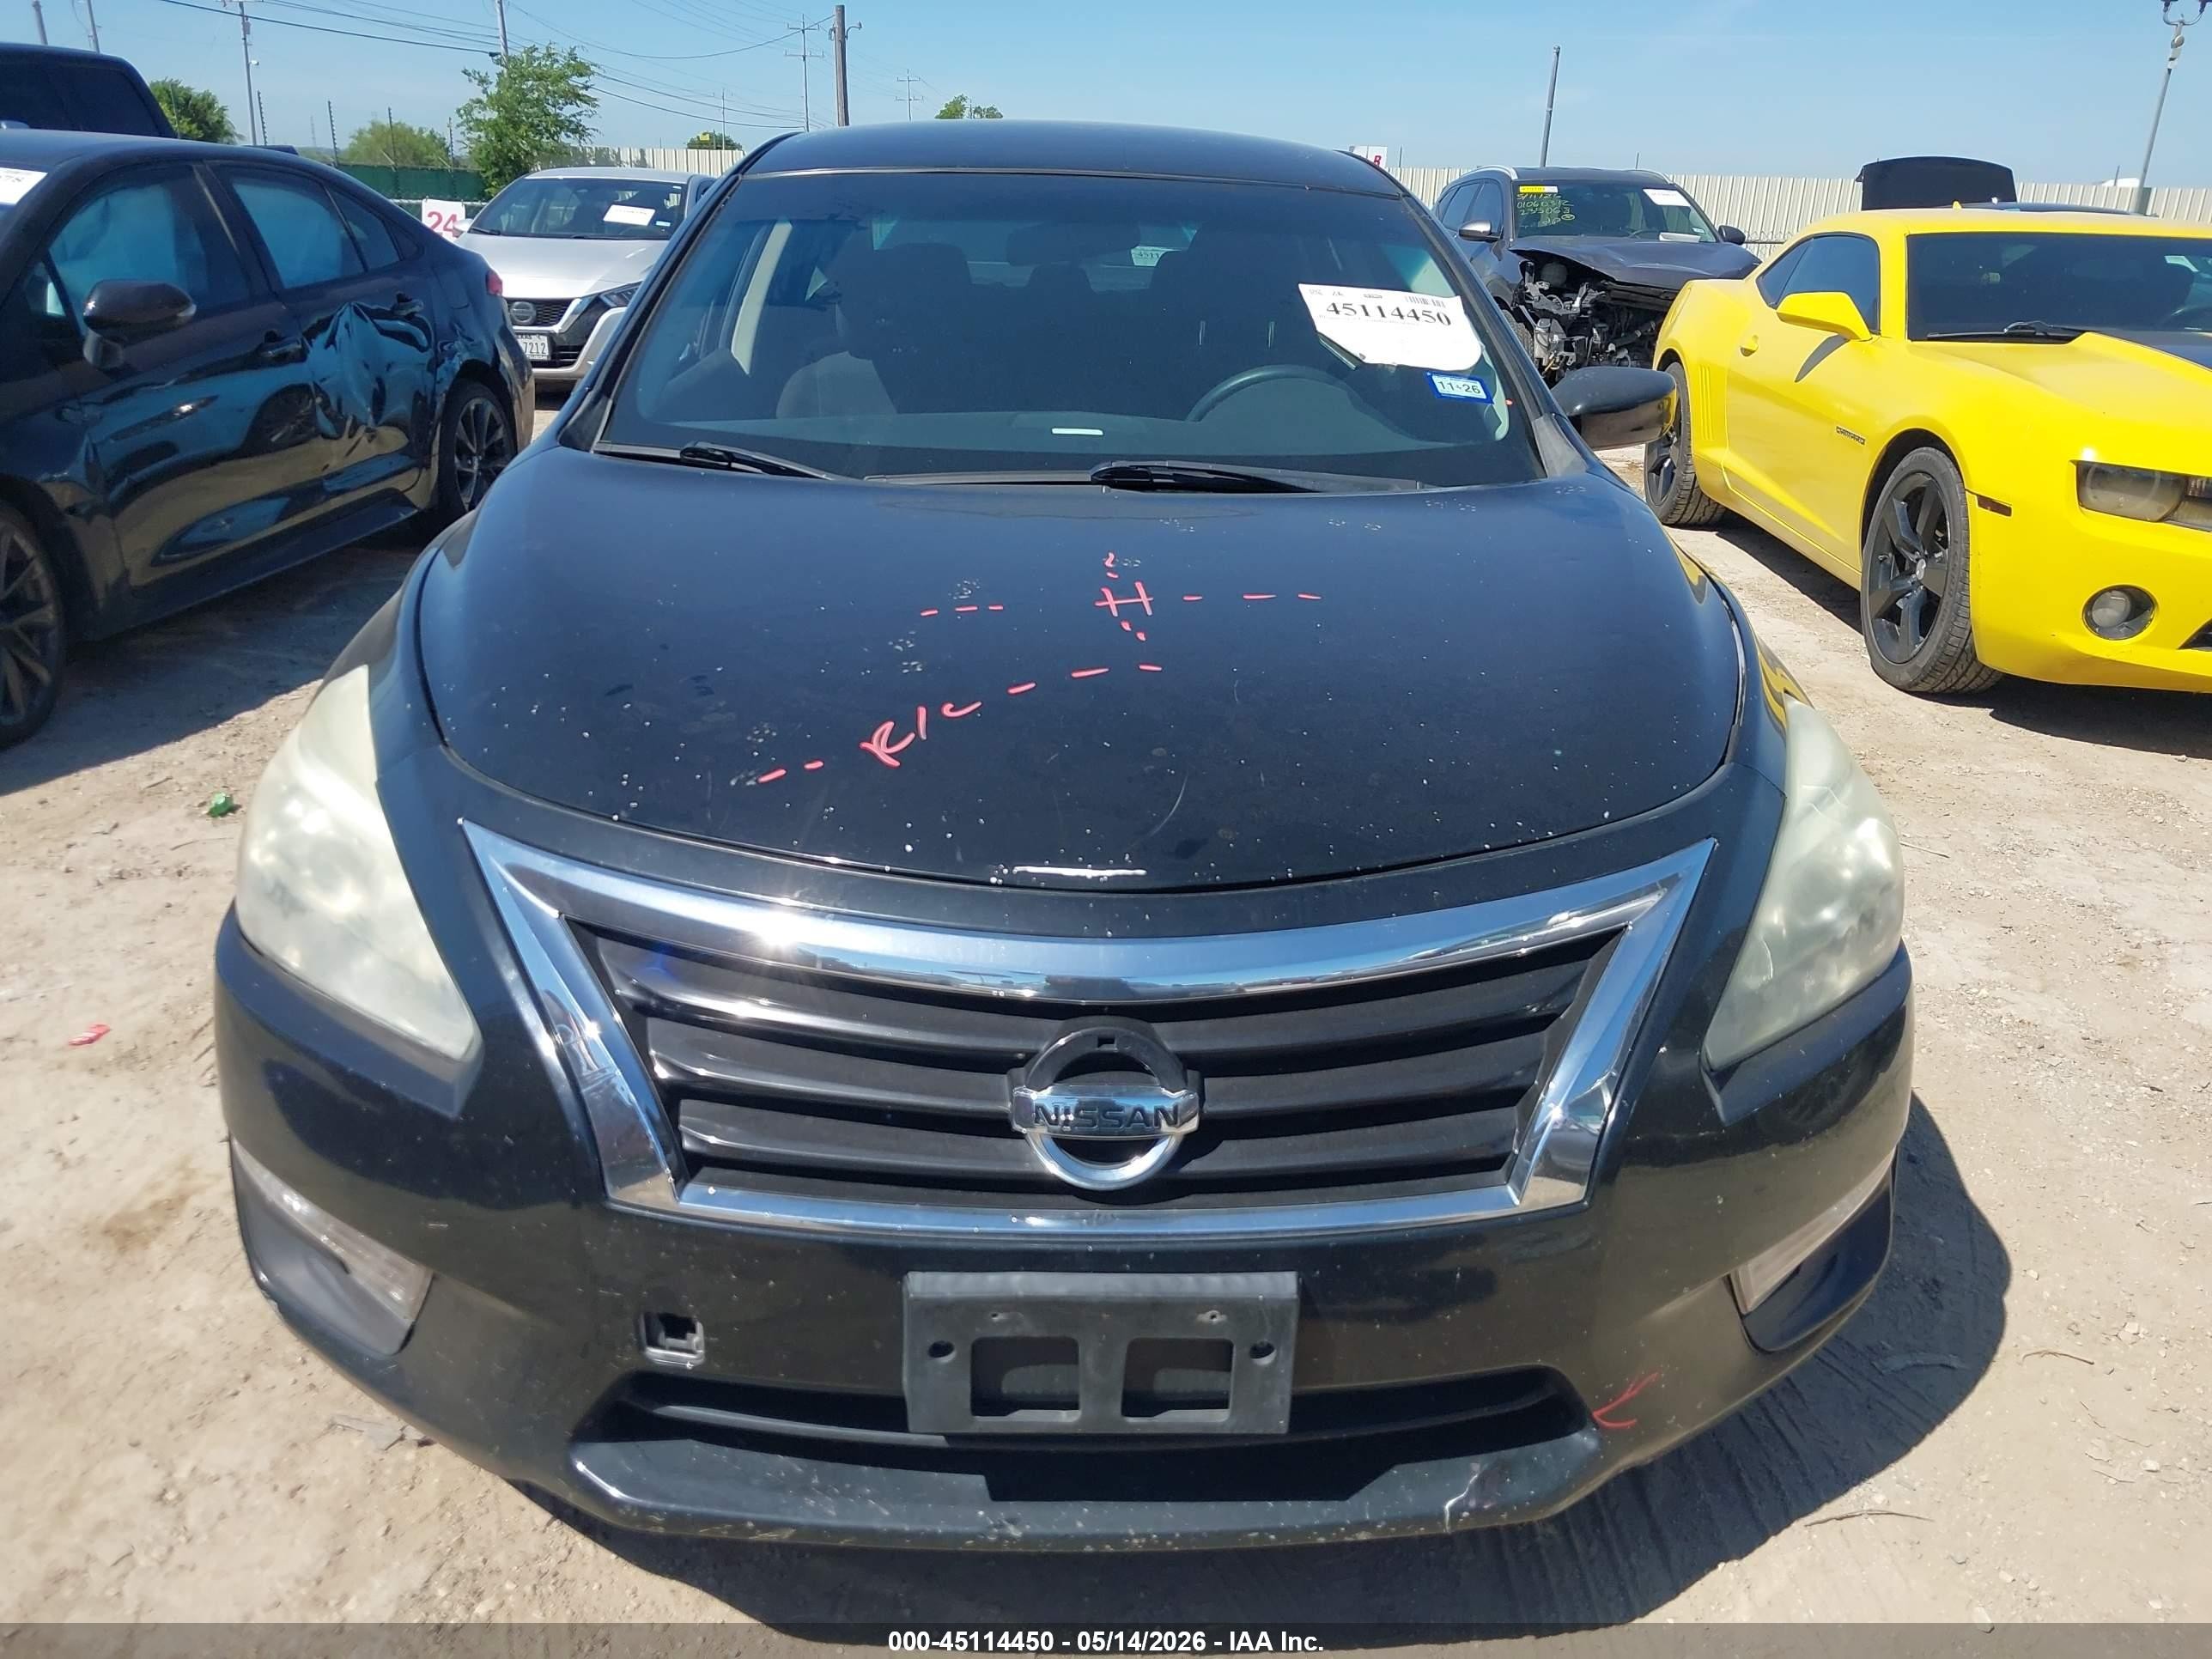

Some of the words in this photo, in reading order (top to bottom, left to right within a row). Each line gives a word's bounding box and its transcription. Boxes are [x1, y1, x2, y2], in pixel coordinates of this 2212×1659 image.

[428, 211, 458, 238] 24
[1327, 301, 1452, 326] 45114450
[523, 341, 547, 354] 7212
[1034, 1103, 1179, 1128] NISSAN
